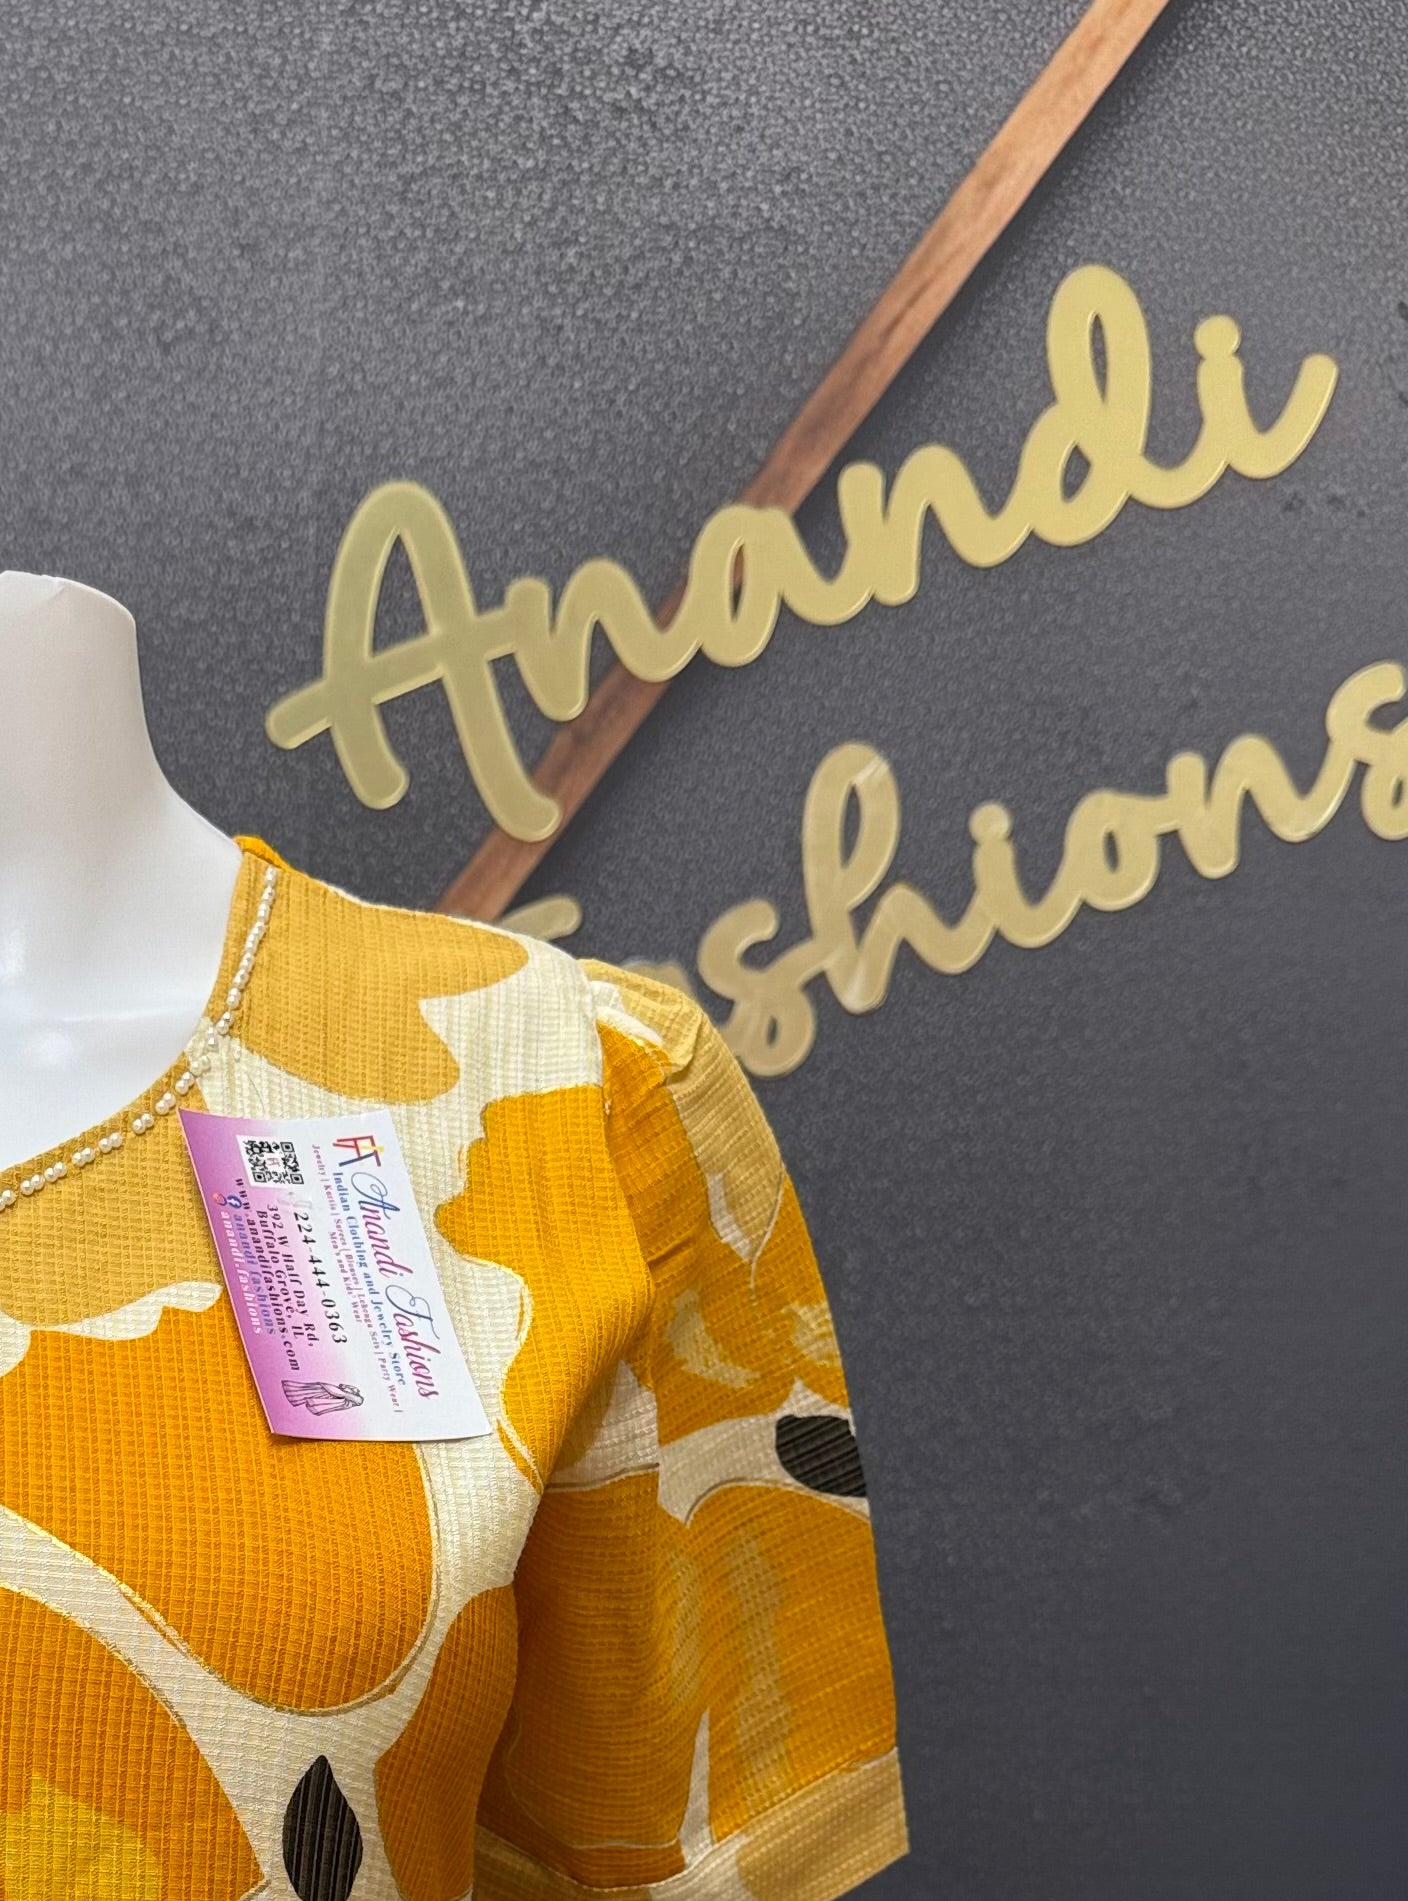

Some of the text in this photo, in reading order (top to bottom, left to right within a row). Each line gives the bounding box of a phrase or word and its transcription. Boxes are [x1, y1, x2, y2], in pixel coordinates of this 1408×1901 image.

[266, 264, 1339, 842] Anandi
[500, 661, 1408, 1077] shions
[220, 1211, 262, 1334] anandi.fashions
[233, 1214, 276, 1335] anandi fashions
[235, 1178, 300, 1371] www.anandifashions.com
[256, 1210, 280, 1264] Buffalo
[291, 1325, 305, 1339] IL
[266, 1204, 284, 1229] 392
[276, 1235, 289, 1247] W
[281, 1253, 303, 1286] Half
[294, 1211, 348, 1344] 224-444-0363
[293, 1289, 309, 1316] Day
[333, 1172, 406, 1386] Indian Clothing and Jewelry Store
[351, 1171, 441, 1400] Anandi Fashions
[351, 1301, 363, 1323] Wear
[378, 1357, 391, 1381] Party
[388, 1384, 400, 1407] Wear
